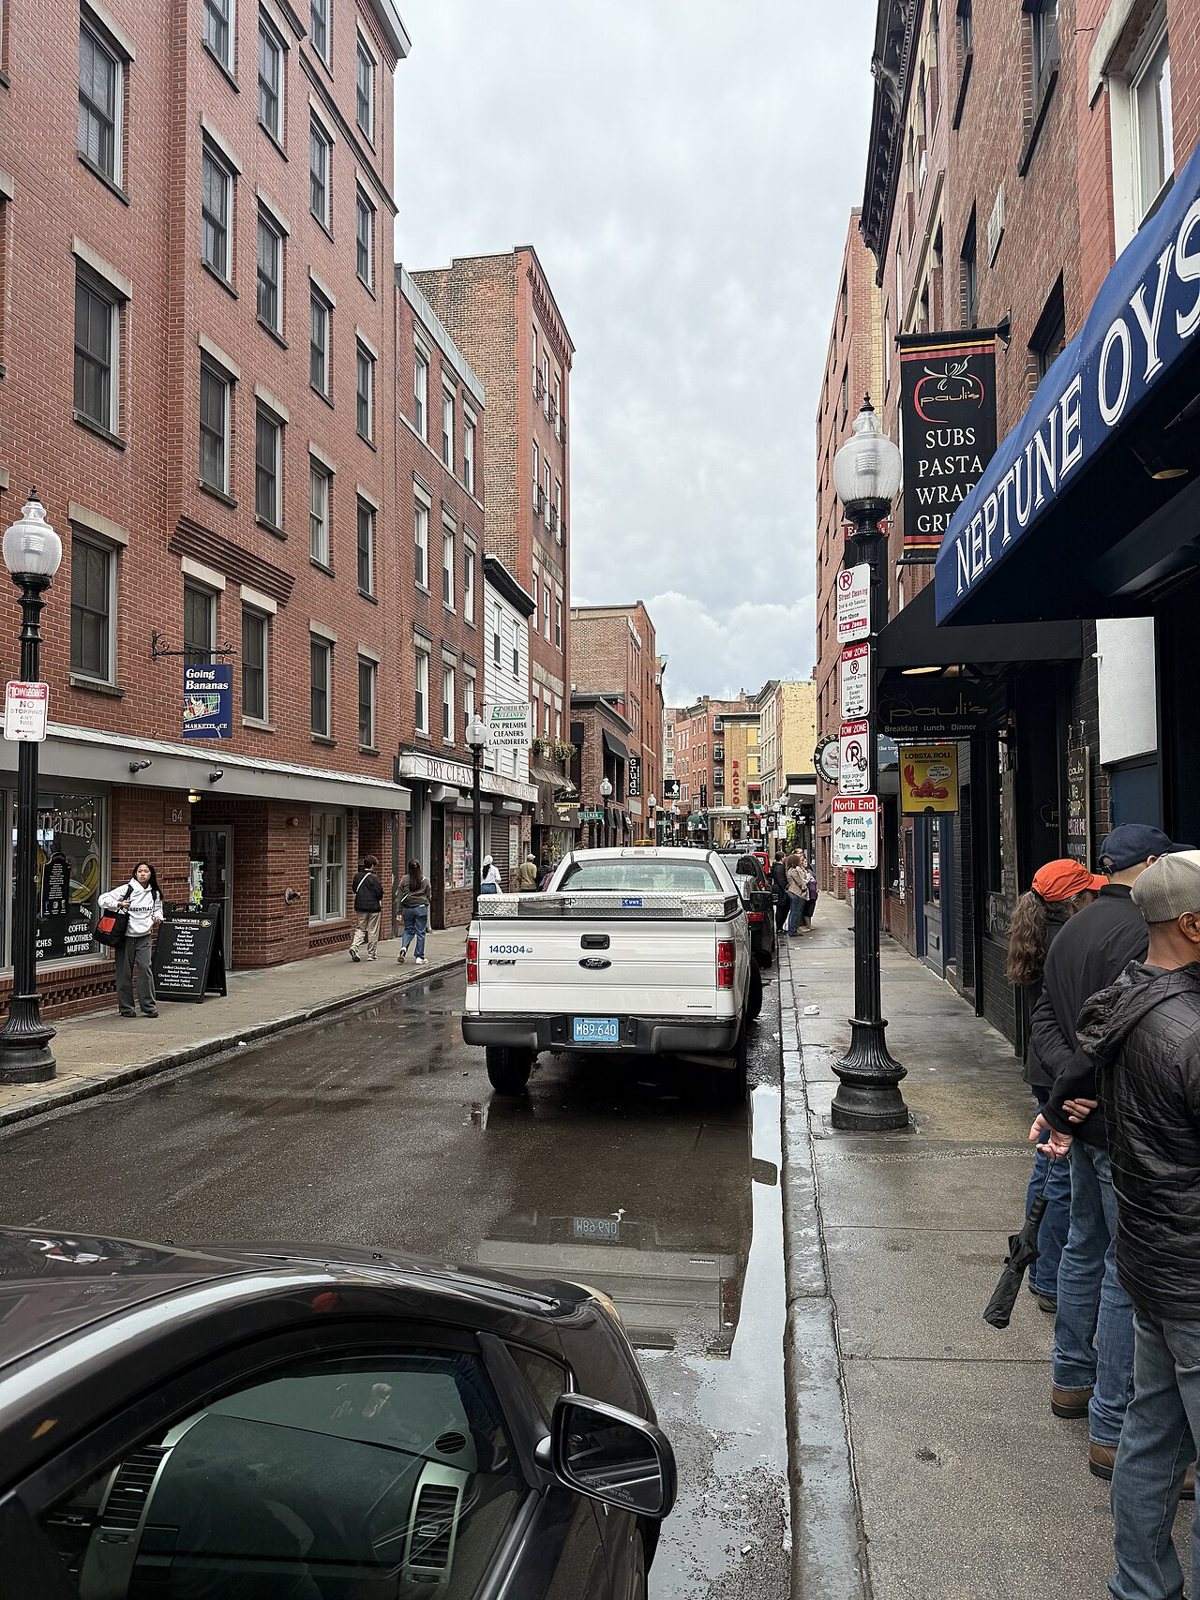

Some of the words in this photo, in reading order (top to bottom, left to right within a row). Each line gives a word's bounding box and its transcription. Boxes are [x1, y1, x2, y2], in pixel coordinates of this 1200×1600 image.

[925, 427, 976, 449] SUBS
[918, 455, 984, 478] PASTA
[956, 374, 1082, 597] NEPTUNE
[186, 668, 215, 680] Going
[185, 680, 229, 690] Bananas
[20, 701, 34, 709] NO
[884, 724, 918, 732] Breakfast
[951, 723, 977, 731] Dinner
[493, 730, 524, 738] CLEANERS
[489, 738, 529, 746] LAUNDERERS
[427, 760, 444, 778] DRY
[834, 800, 855, 810] North
[858, 800, 874, 810] End
[171, 808, 183, 822] 64
[843, 816, 864, 825] Permit
[841, 829, 866, 839] Parking
[68, 924, 88, 934] COFFEE
[64, 934, 93, 944] SMOOTHIES
[67, 943, 90, 953] MUFFINS
[489, 945, 525, 954] 140304
[585, 958, 604, 967] Ford
